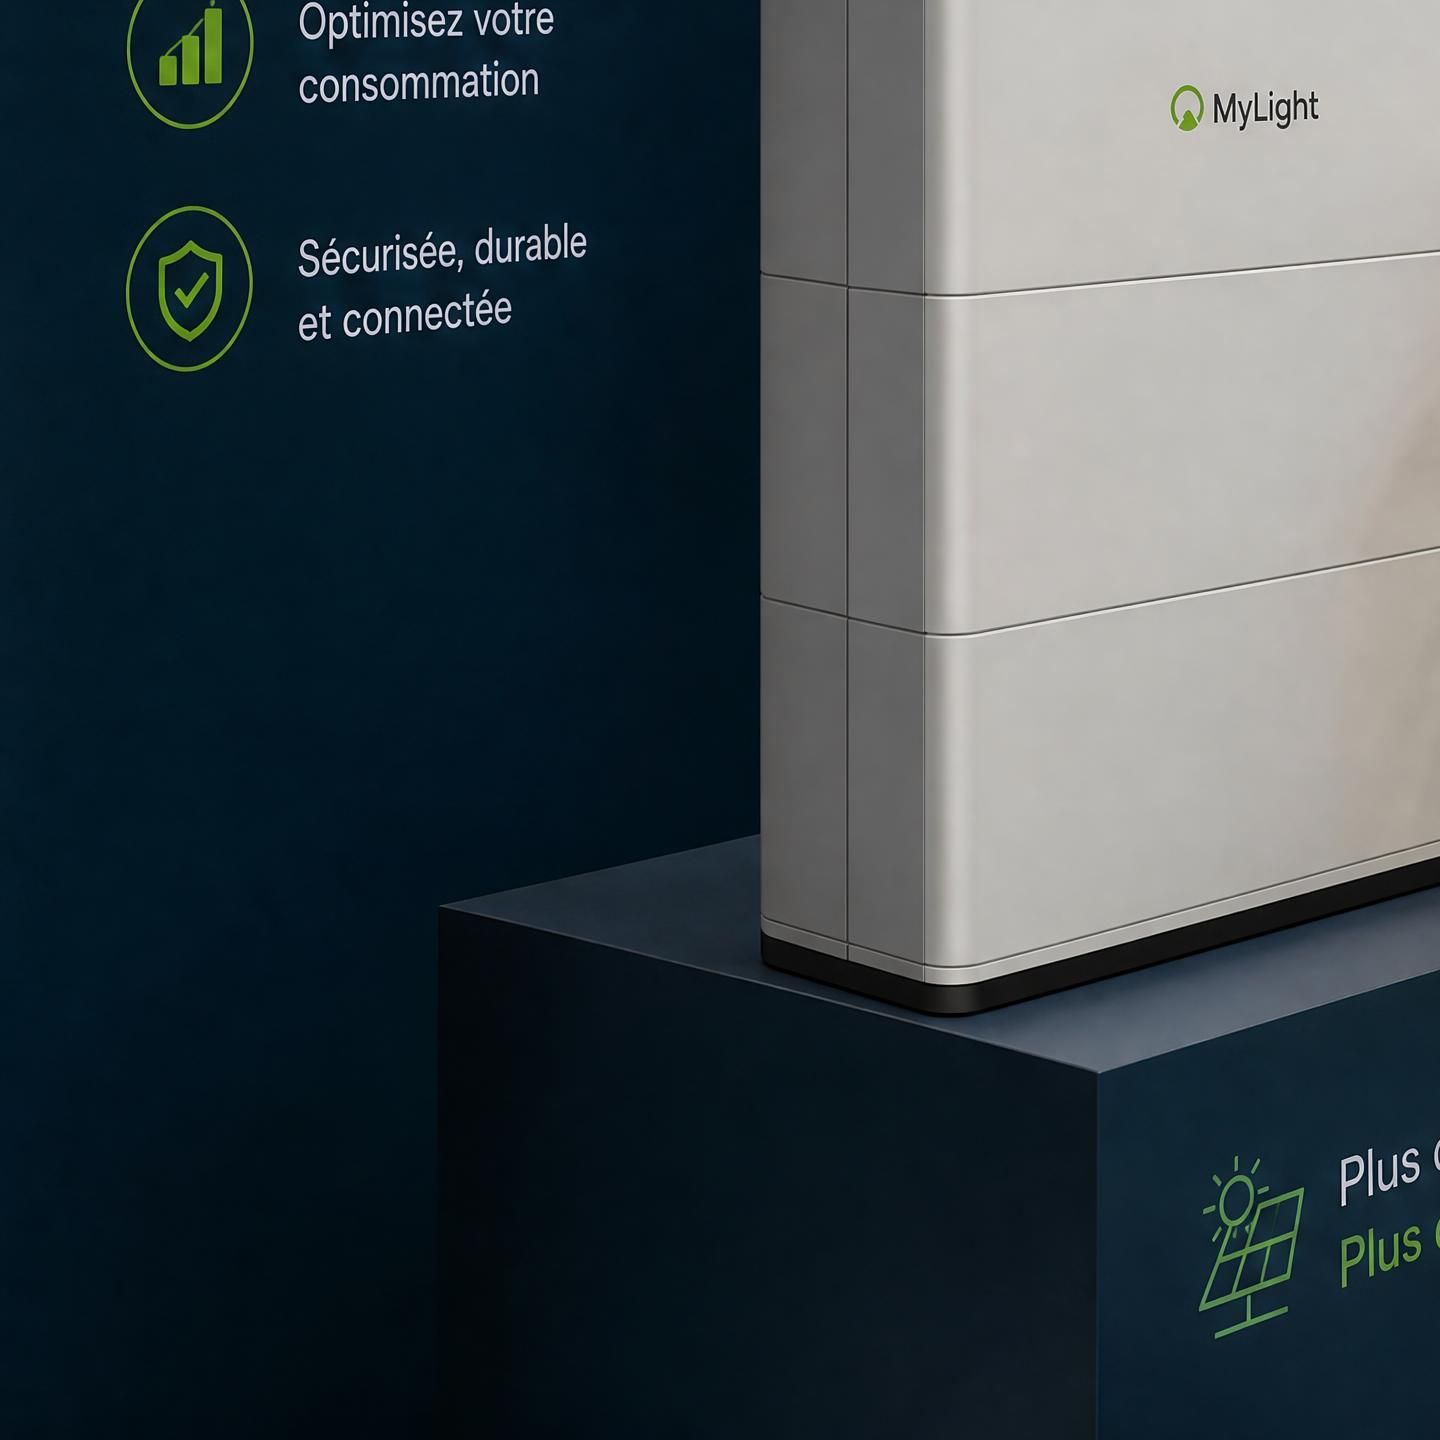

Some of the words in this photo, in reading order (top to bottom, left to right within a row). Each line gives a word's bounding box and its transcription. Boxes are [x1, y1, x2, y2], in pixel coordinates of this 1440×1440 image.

[300, 1, 462, 49] Optimisez
[474, 2, 553, 35] votre
[300, 60, 538, 103] consommation
[1214, 90, 1318, 131] MyLight
[299, 232, 463, 277] Sécurisée,
[476, 223, 586, 264] durable
[299, 306, 331, 341] et
[344, 289, 511, 337] connectée
[1341, 1148, 1420, 1206] Plus
[1342, 1226, 1421, 1288] Plus
